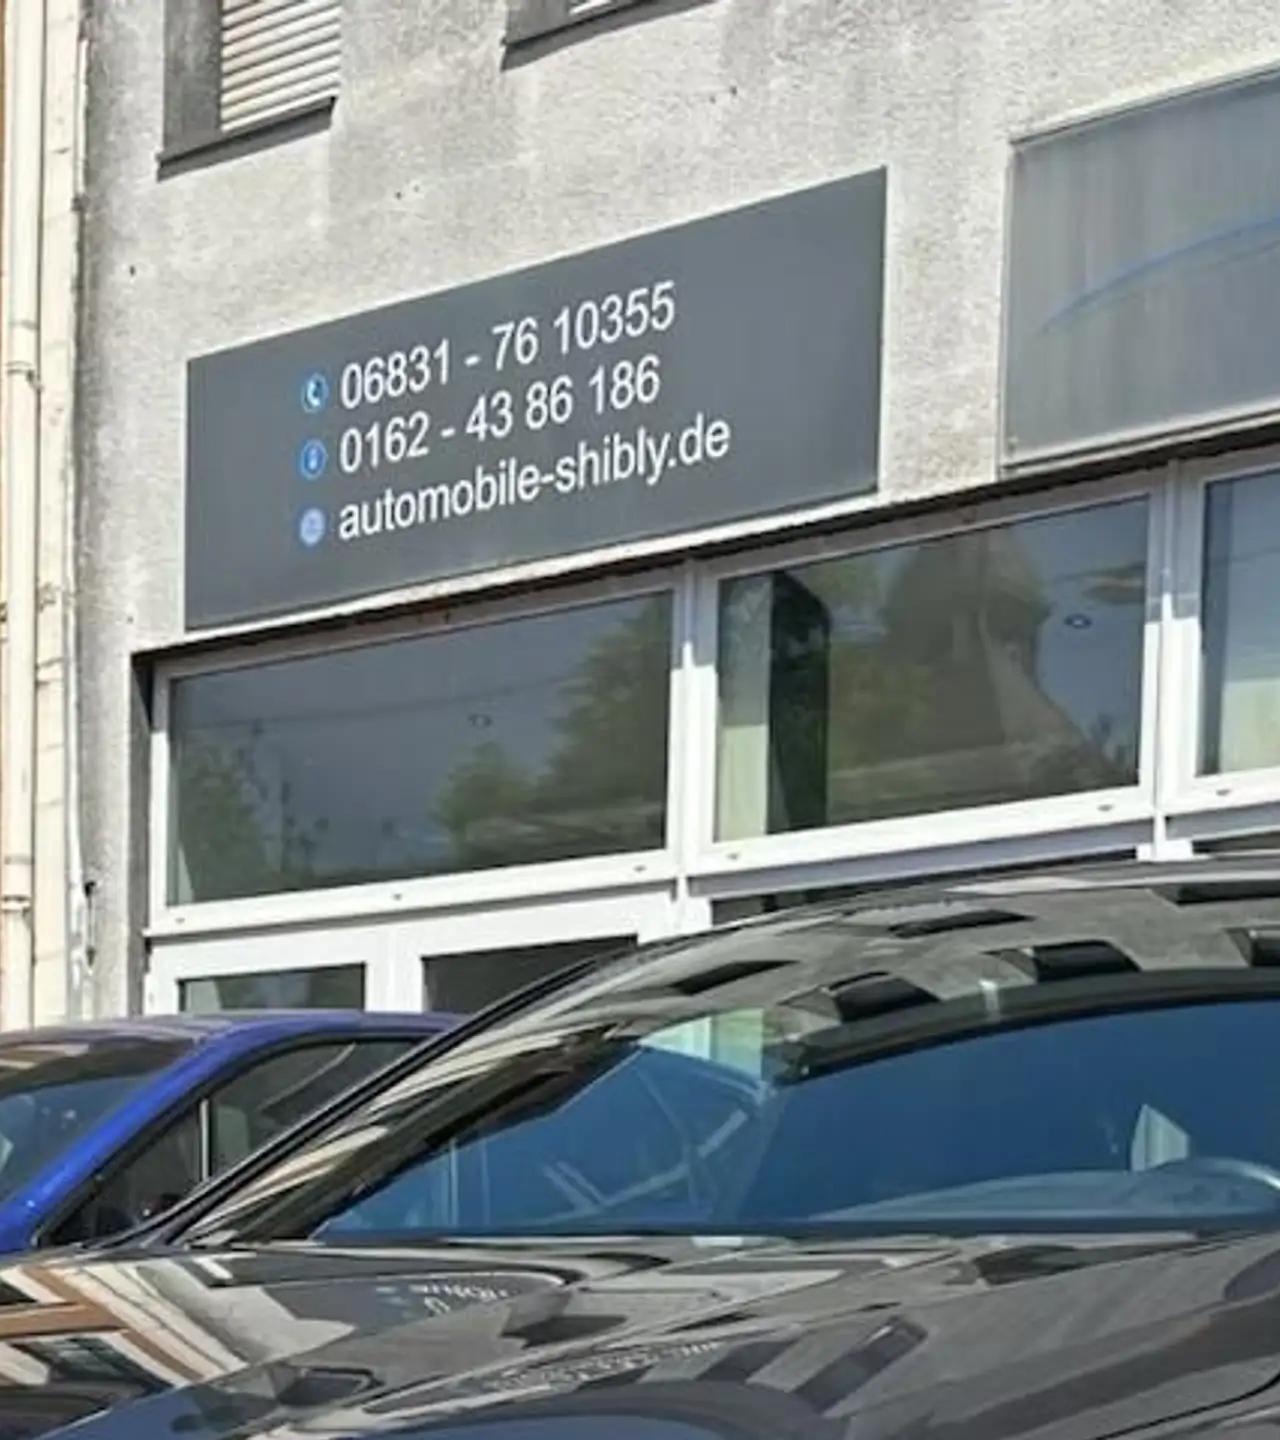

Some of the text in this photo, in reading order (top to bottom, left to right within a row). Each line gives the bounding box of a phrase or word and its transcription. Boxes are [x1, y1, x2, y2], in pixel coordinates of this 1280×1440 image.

[340, 338, 451, 410] 06831
[492, 316, 540, 371] 76
[553, 279, 677, 354] 10355
[338, 411, 732, 541] automobile-shibly.de
[339, 411, 430, 474] 0162
[465, 390, 513, 442] 43
[525, 374, 574, 430] 86
[588, 353, 661, 414] 186
